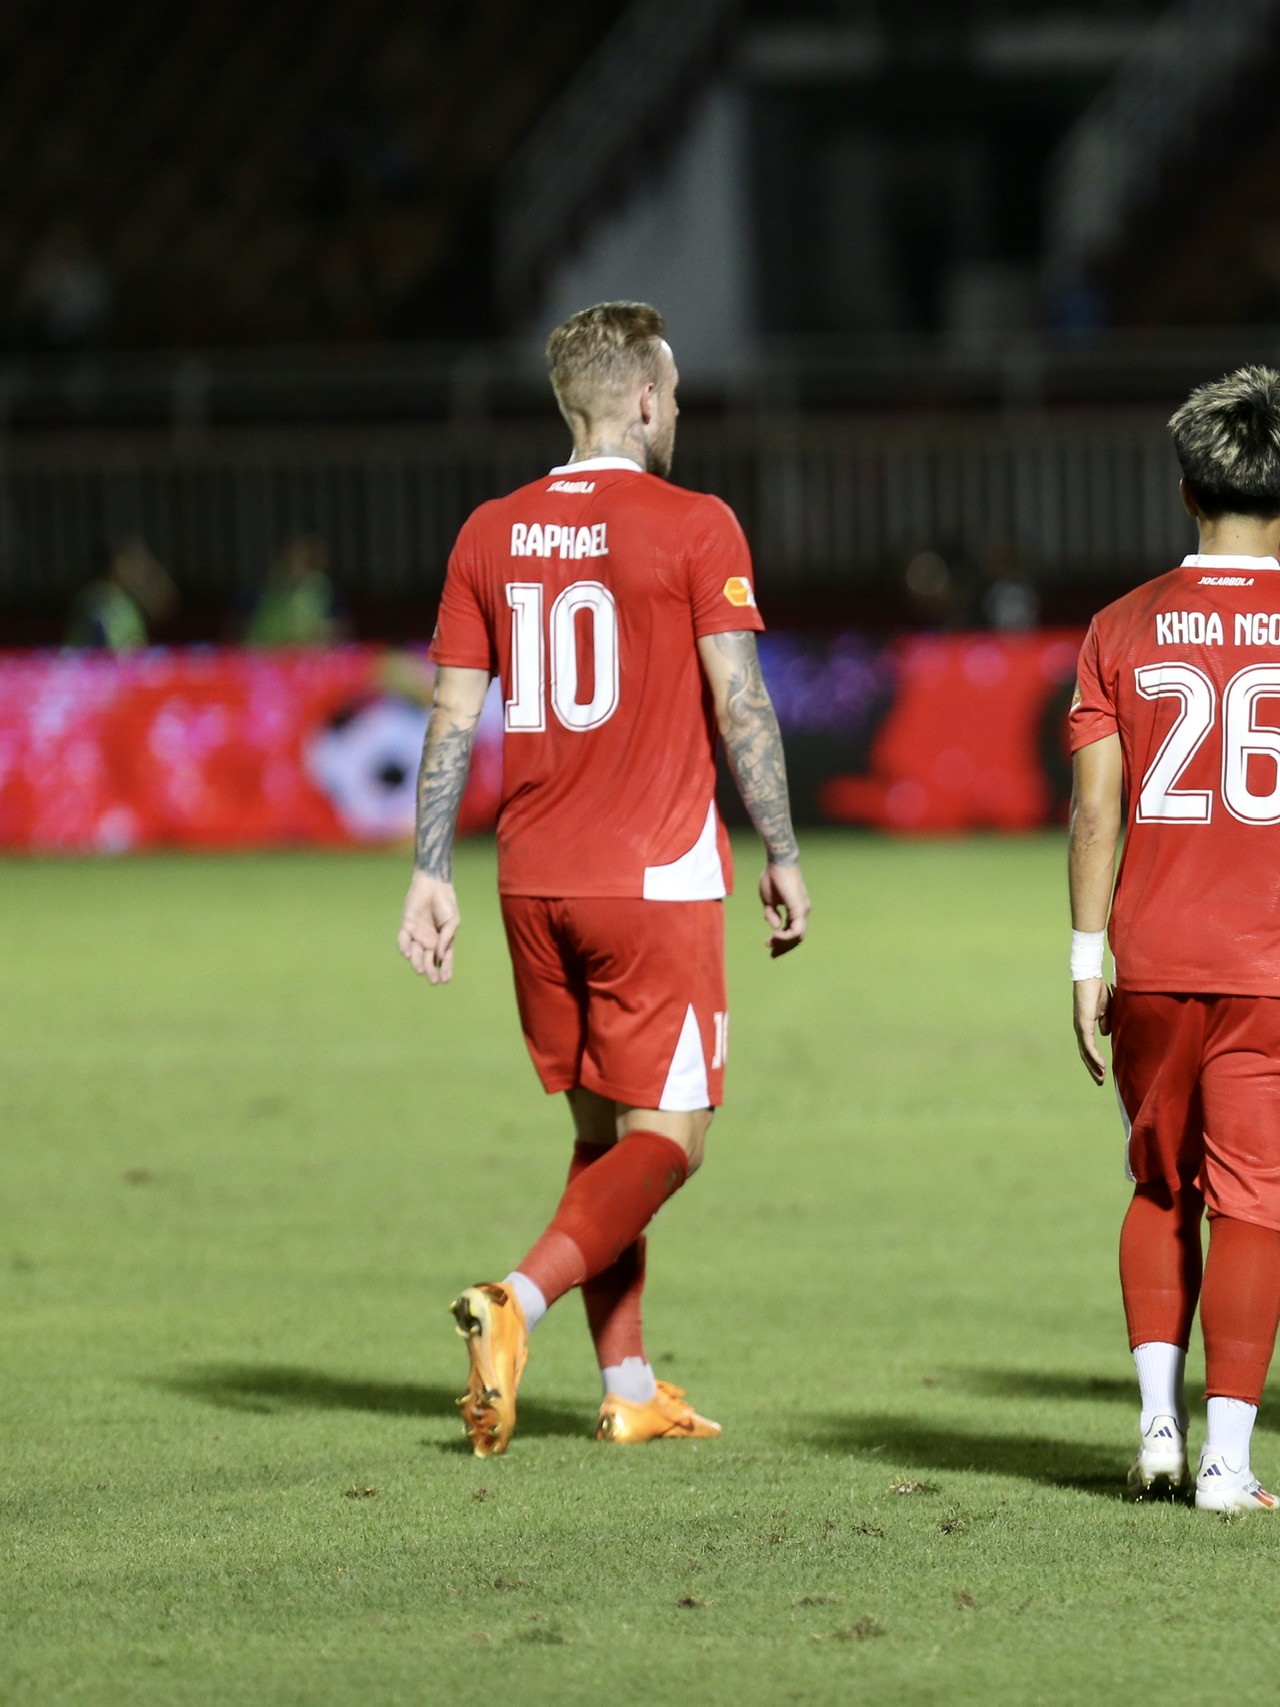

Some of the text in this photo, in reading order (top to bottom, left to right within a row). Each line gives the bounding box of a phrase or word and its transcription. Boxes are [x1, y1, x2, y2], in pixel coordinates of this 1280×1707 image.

[511, 522, 609, 559] RAPHAEL
[1155, 611, 1224, 646] KHOA
[504, 580, 621, 733] 10
